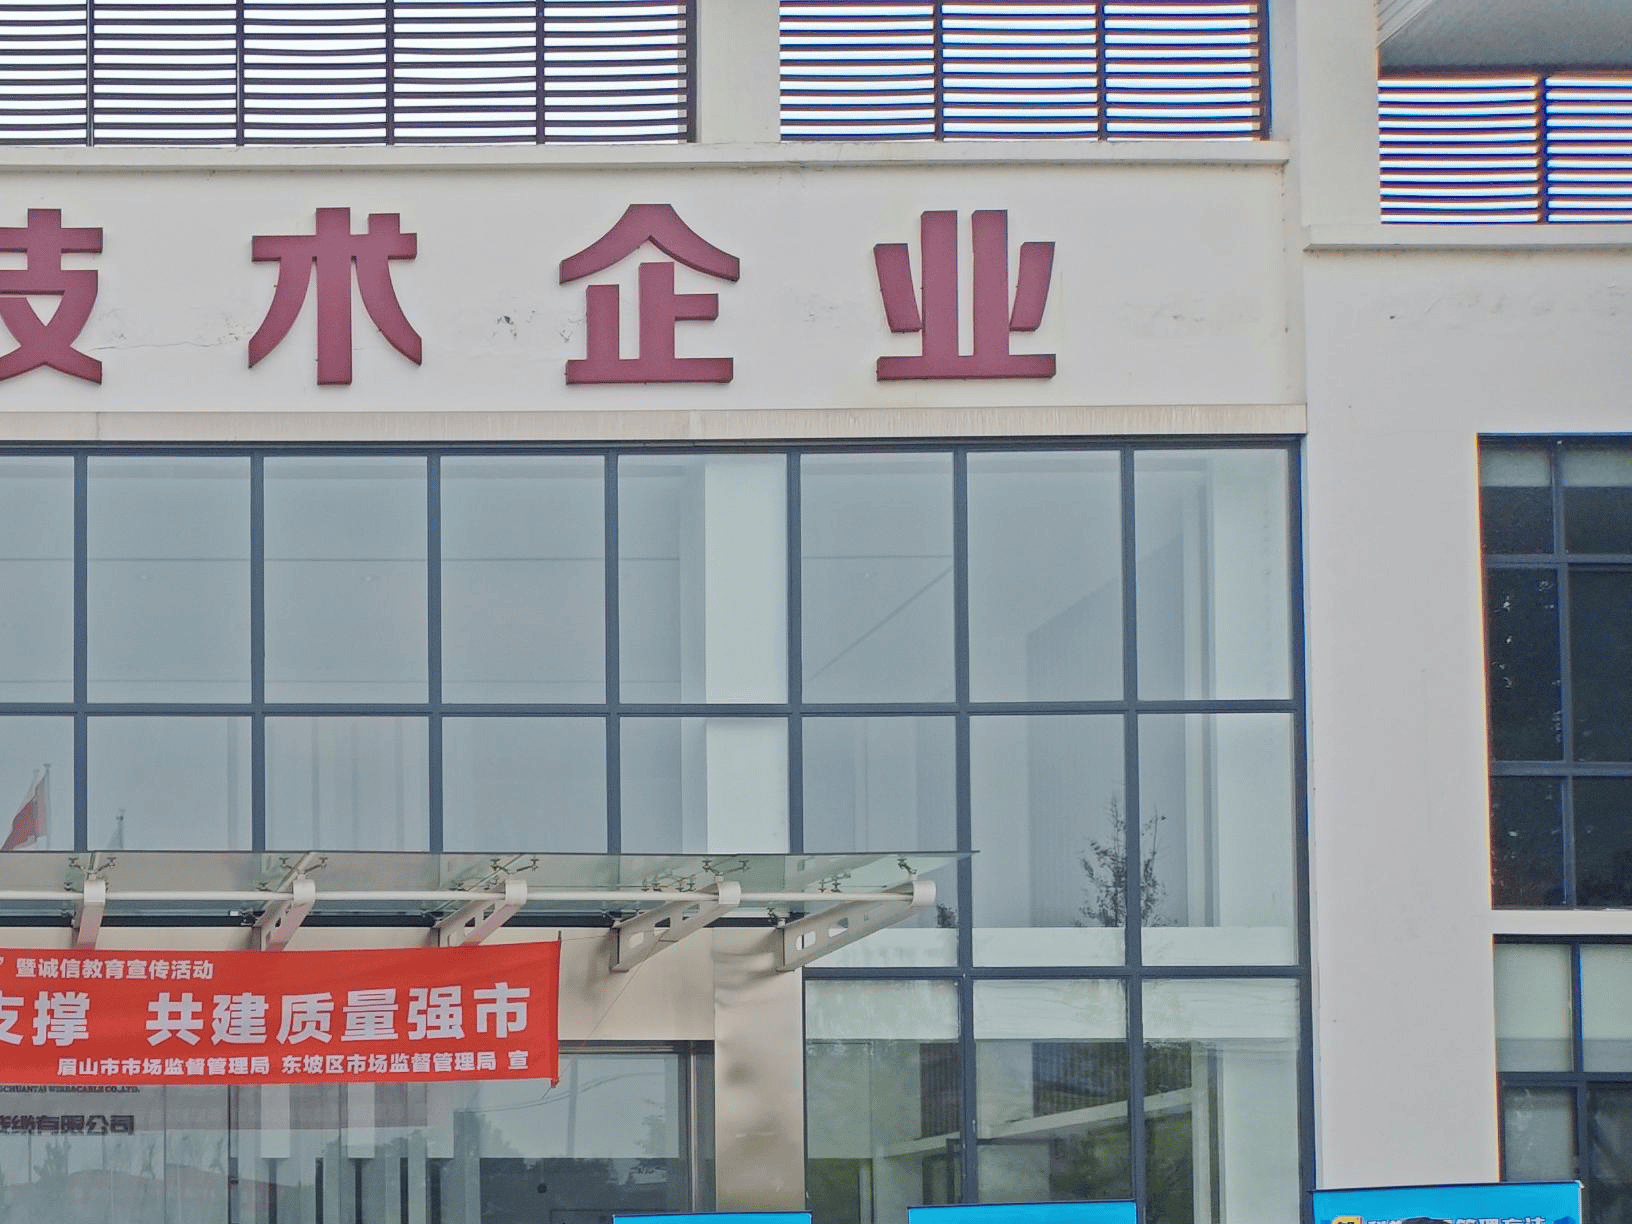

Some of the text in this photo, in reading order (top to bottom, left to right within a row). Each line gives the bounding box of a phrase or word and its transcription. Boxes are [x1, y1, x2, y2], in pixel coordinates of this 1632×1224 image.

[146, 981, 531, 1046] 共建质量强市
[57, 1049, 529, 1077] 眉山市市场监督管理局 东坡区市场监督管理局 宣
